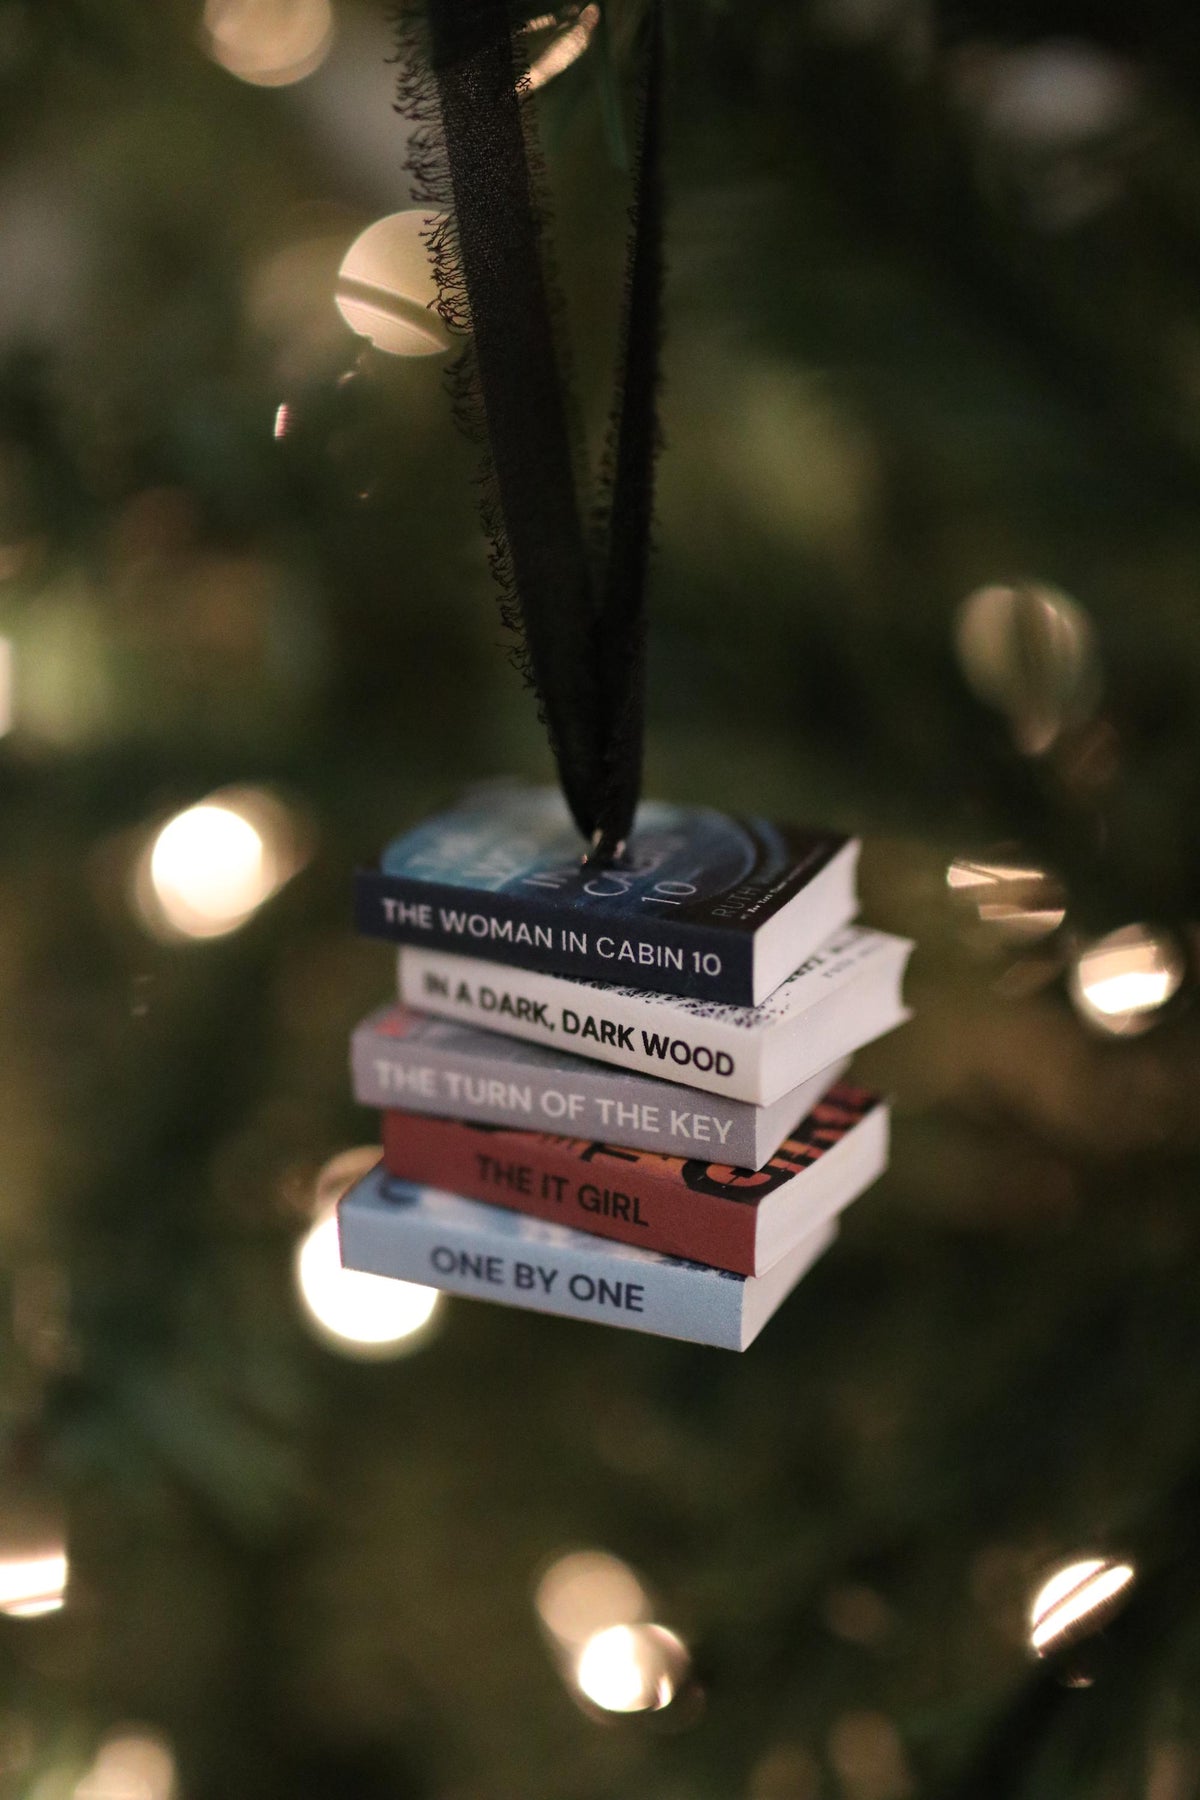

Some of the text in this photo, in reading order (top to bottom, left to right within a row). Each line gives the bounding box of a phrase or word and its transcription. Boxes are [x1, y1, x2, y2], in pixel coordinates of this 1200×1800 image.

[382, 898, 722, 976] THE WOMAN IN CABIN 10
[423, 970, 735, 1076] IN A DARK, DARK WOOD
[375, 1059, 437, 1098] THE
[444, 1071, 533, 1114] TURN
[540, 1090, 587, 1121] OF
[595, 1098, 660, 1133] THE
[670, 1109, 733, 1145] KEY
[477, 1153, 649, 1227] THE IT GIRL
[430, 1246, 645, 1313] ONE BY ONE
